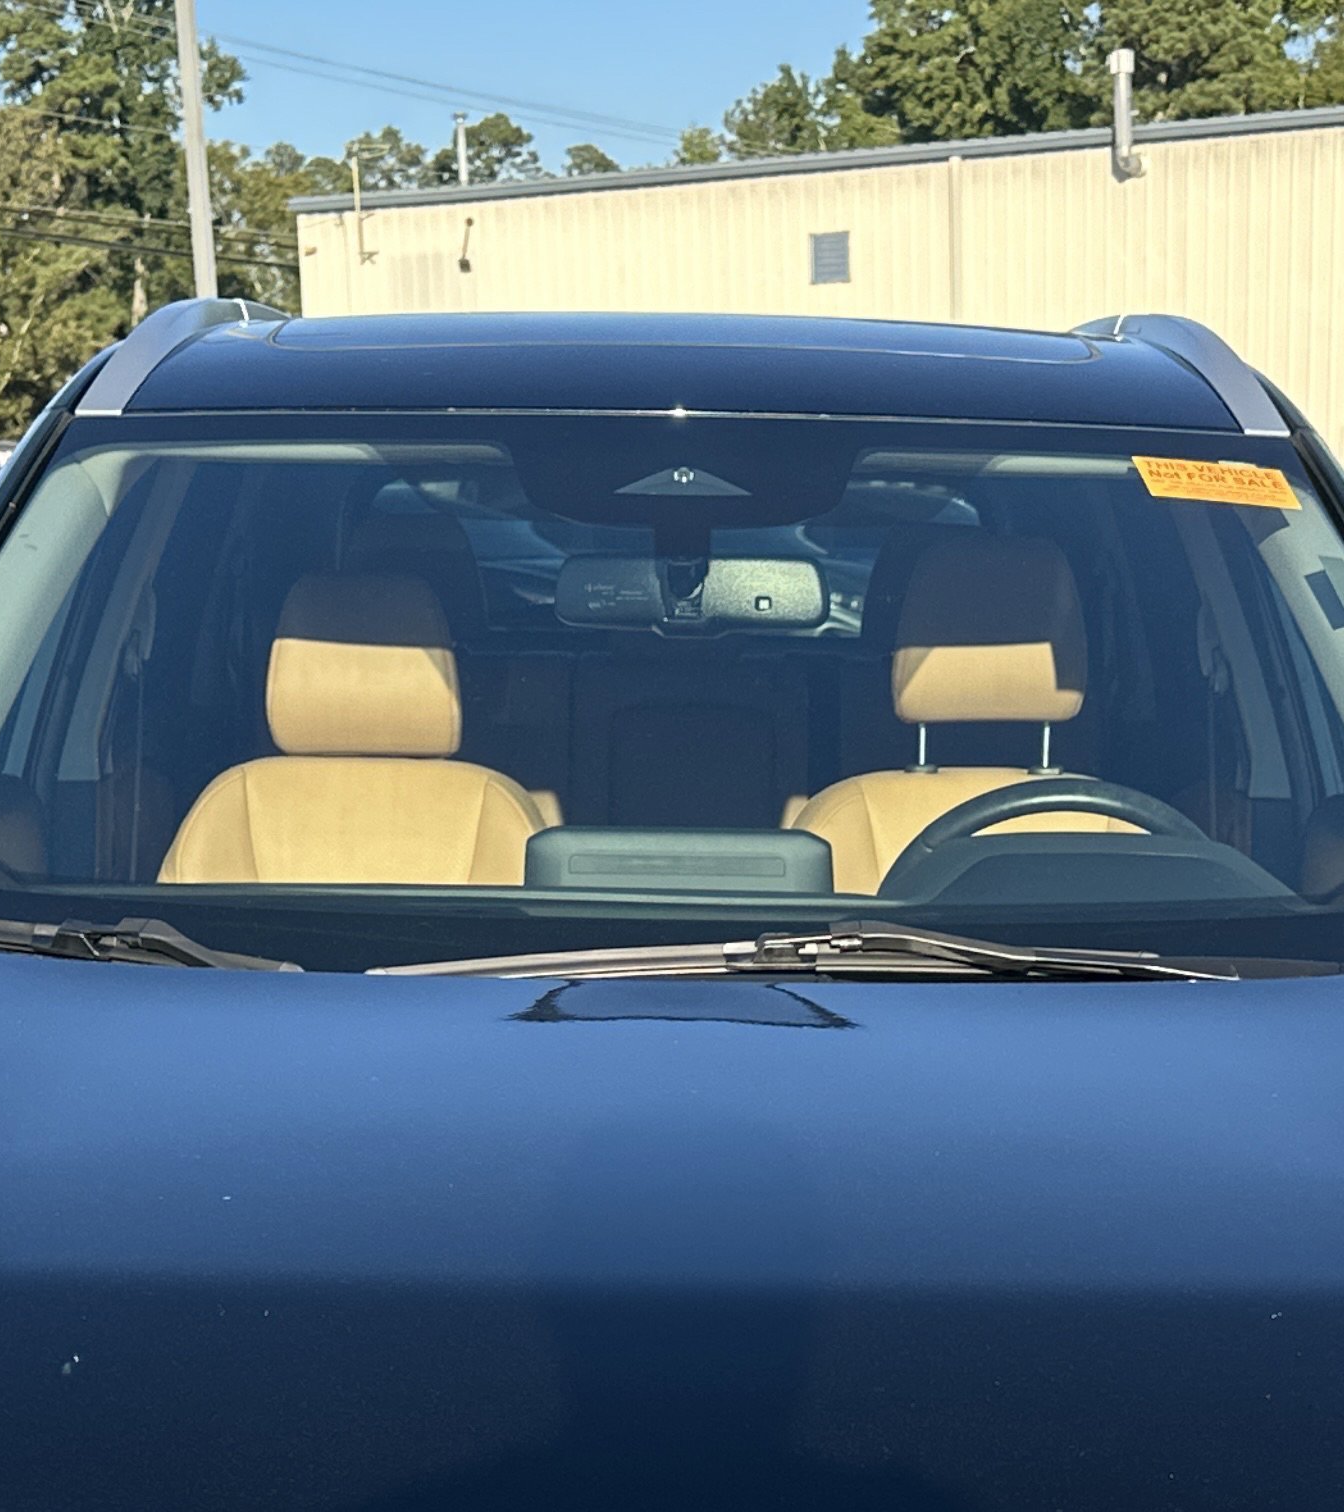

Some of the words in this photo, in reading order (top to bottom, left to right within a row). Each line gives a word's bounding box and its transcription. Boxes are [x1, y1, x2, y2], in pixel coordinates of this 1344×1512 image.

[1146, 461, 1188, 471] THIS
[1192, 464, 1274, 480] VEHICLE
[1187, 472, 1227, 484] FOR
[1233, 477, 1286, 490] SALE
